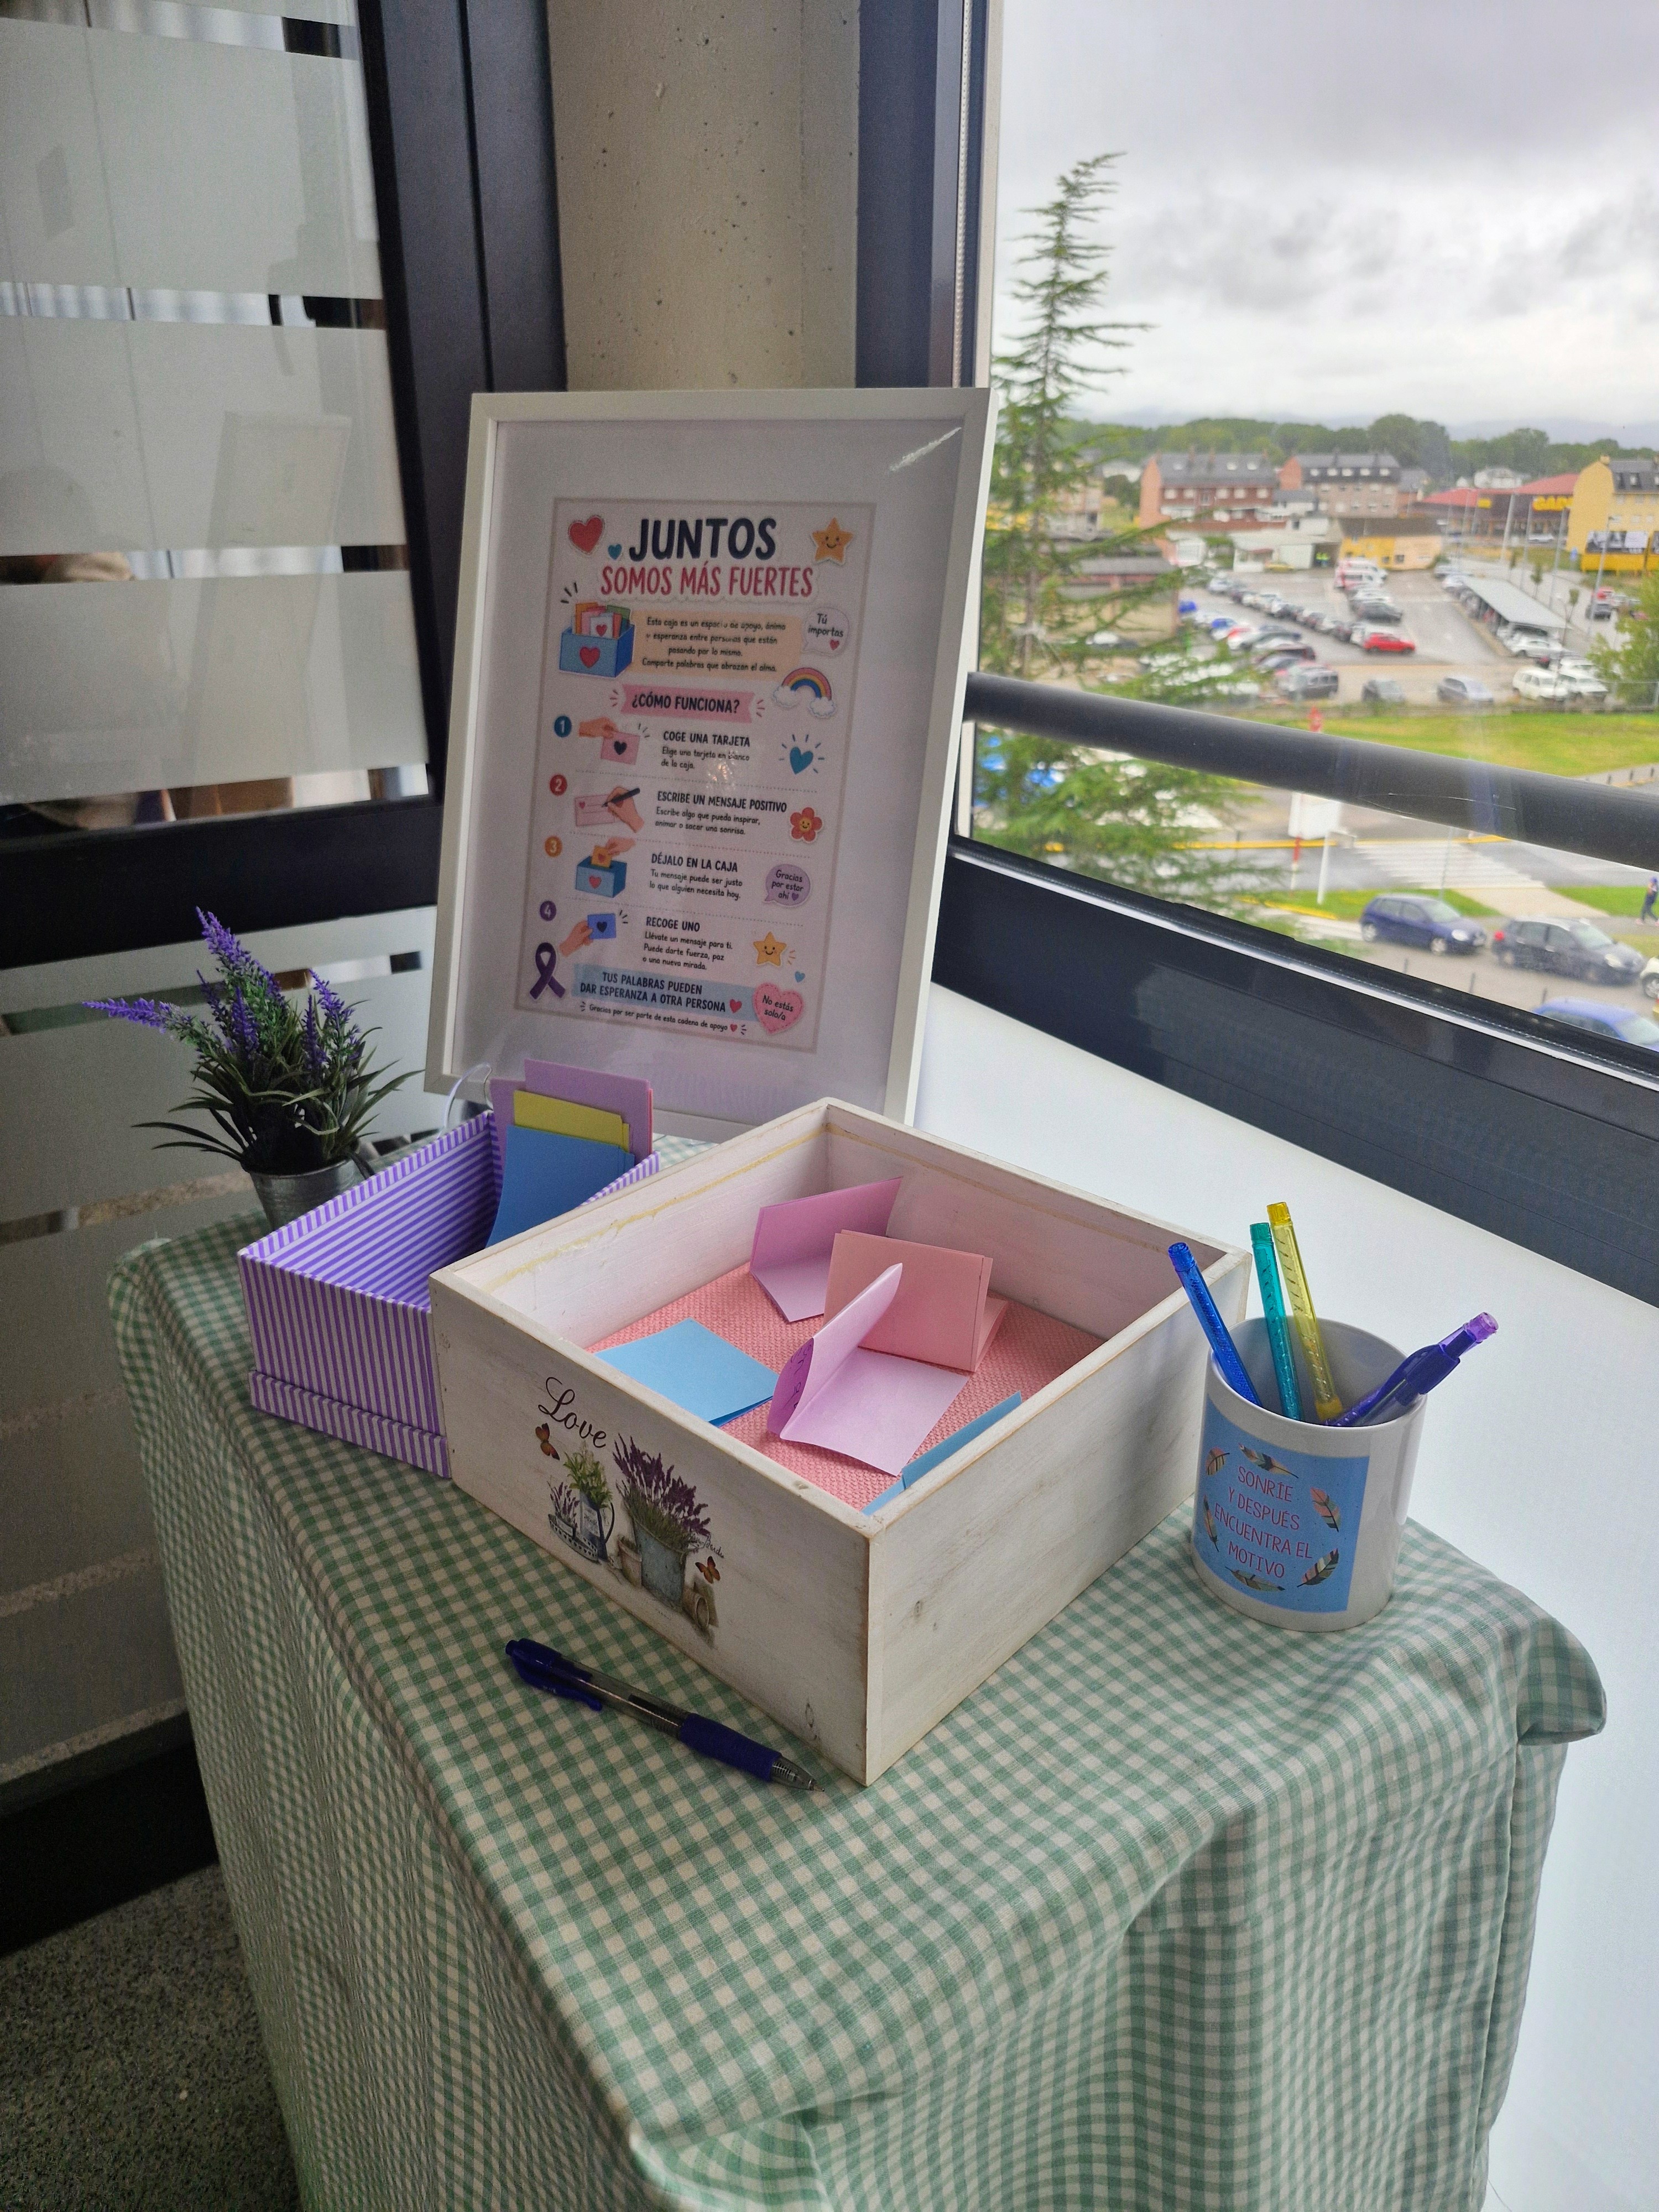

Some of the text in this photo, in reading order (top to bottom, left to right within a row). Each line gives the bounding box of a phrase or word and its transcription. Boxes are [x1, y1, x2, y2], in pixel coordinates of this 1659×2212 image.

[629, 518, 777, 562] JUNTOS
[601, 561, 813, 597] SOMOS MÁS FUERTES
[647, 617, 661, 625] Esta
[664, 619, 678, 629] caja
[741, 623, 763, 632] apoyo,
[765, 622, 786, 630] ánimo
[817, 613, 827, 624] Tú
[653, 634, 687, 642] esperanza
[744, 637, 755, 645] que
[758, 636, 778, 644] están
[808, 626, 844, 638] importas
[668, 647, 696, 656] pasando
[642, 658, 674, 669] Comparte
[676, 660, 704, 670] palabras
[721, 662, 748, 671] abrazan
[751, 663, 757, 671] el
[632, 691, 740, 713] ¿CÓMO FUNCIONA?
[560, 720, 565, 734] 1
[663, 731, 750, 747] COGE UNA TARJETA
[662, 747, 677, 758] Elige
[694, 749, 716, 760] tarjeta
[680, 761, 695, 771] caja.
[555, 779, 562, 791] 2
[658, 791, 787, 812] ESCRIBE UN MENSAJE POSITIVO
[656, 806, 760, 826] Escribe algo que pueda inspirar,
[655, 820, 677, 828] animar
[720, 826, 746, 835] sonrisa.
[550, 840, 557, 853] 3
[651, 852, 738, 873] DÉJALO EN LA CAJA
[651, 869, 659, 877] Tu
[661, 872, 687, 883] mensaje
[690, 875, 709, 883] puede
[724, 878, 743, 888] justo
[776, 869, 802, 883] Gracias
[649, 880, 655, 889] lo
[671, 884, 695, 894] alguien
[697, 888, 724, 896] necesita
[727, 890, 741, 901] hoy.
[771, 881, 784, 889] por
[544, 904, 551, 918] 4
[646, 916, 700, 932] RECOGE UNO
[645, 931, 668, 941] Llévate
[680, 938, 707, 948] mensaje
[644, 943, 724, 962] Puede darte fuerza, paz
[684, 961, 707, 970] mirada.
[602, 972, 702, 995] TUS PALABRAS PUEDEN
[580, 983, 726, 1012] DAR ESPERANZA A OTRA PERSONA
[763, 995, 794, 1012] No estás
[589, 1004, 612, 1014] Gracias
[677, 1018, 698, 1026] cadena
[709, 1023, 728, 1032] apoyo
[764, 1009, 786, 1021] solo/a
[538, 1377, 607, 1448] Love
[1238, 1466, 1293, 1503] SONRÍE
[1229, 1486, 1300, 1530] Y DESPUÉS
[1214, 1503, 1313, 1559] ENCUENTRA EL
[1228, 1541, 1285, 1578] MOTIVO
